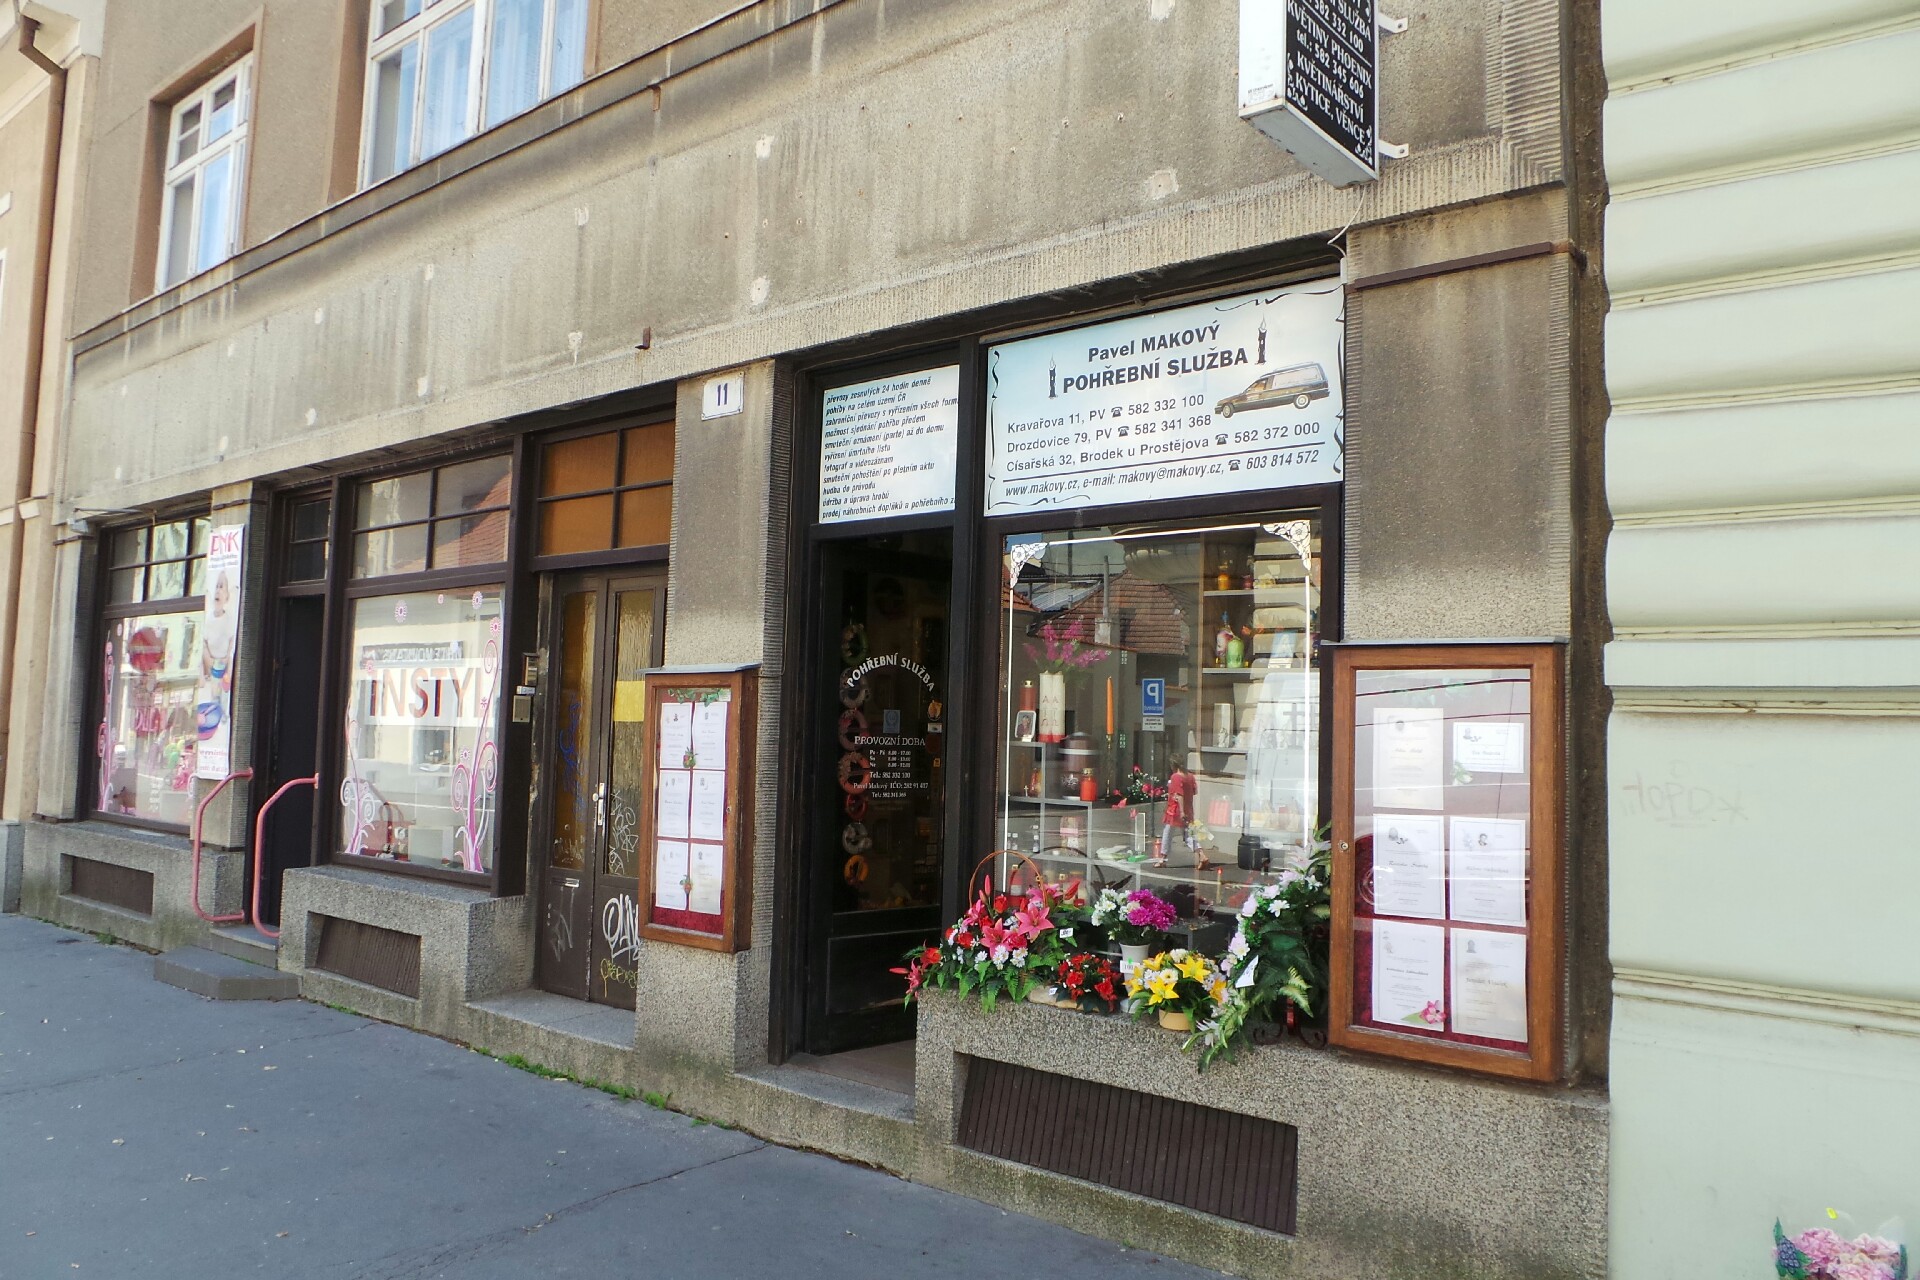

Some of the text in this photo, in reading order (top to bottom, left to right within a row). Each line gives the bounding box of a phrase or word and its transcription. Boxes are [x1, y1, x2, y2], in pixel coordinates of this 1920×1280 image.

[1332, 12, 1347, 37] 332
[1350, 31, 1364, 53] 100
[1338, 0, 1371, 42] SLUŽBA
[1288, 0, 1372, 89] KVĚTINY PHOENIX
[1297, 51, 1364, 123] KVĚTINÁŘSTVÍ
[1315, 43, 1330, 69] 582
[1333, 60, 1347, 84] 345
[1350, 75, 1364, 98] 606
[1295, 73, 1365, 145] KYTICE, VĚNCE
[1088, 320, 1221, 363] Pavel MAKOVÝ
[881, 385, 890, 394] 24
[1063, 347, 1248, 393] POHŘEBNÍ SLUŽBA
[717, 383, 728, 406] 11
[897, 392, 906, 402] ČR
[1007, 394, 1205, 433] Kravařova 11, PV 582 332 100
[1006, 421, 1320, 473] Císařská 32, Brodek u Prostějova 582 372 000
[1007, 414, 1212, 453] Drozdovice 79, PV 582 341 368
[1005, 449, 1319, 497] www.makovy.cz, e-mail: makovy@makovy.cz, 603 814 572
[846, 652, 935, 692] POHŘEBNÍ SLUŽBA
[854, 735, 925, 745] PROVOZNÍ DOBA
